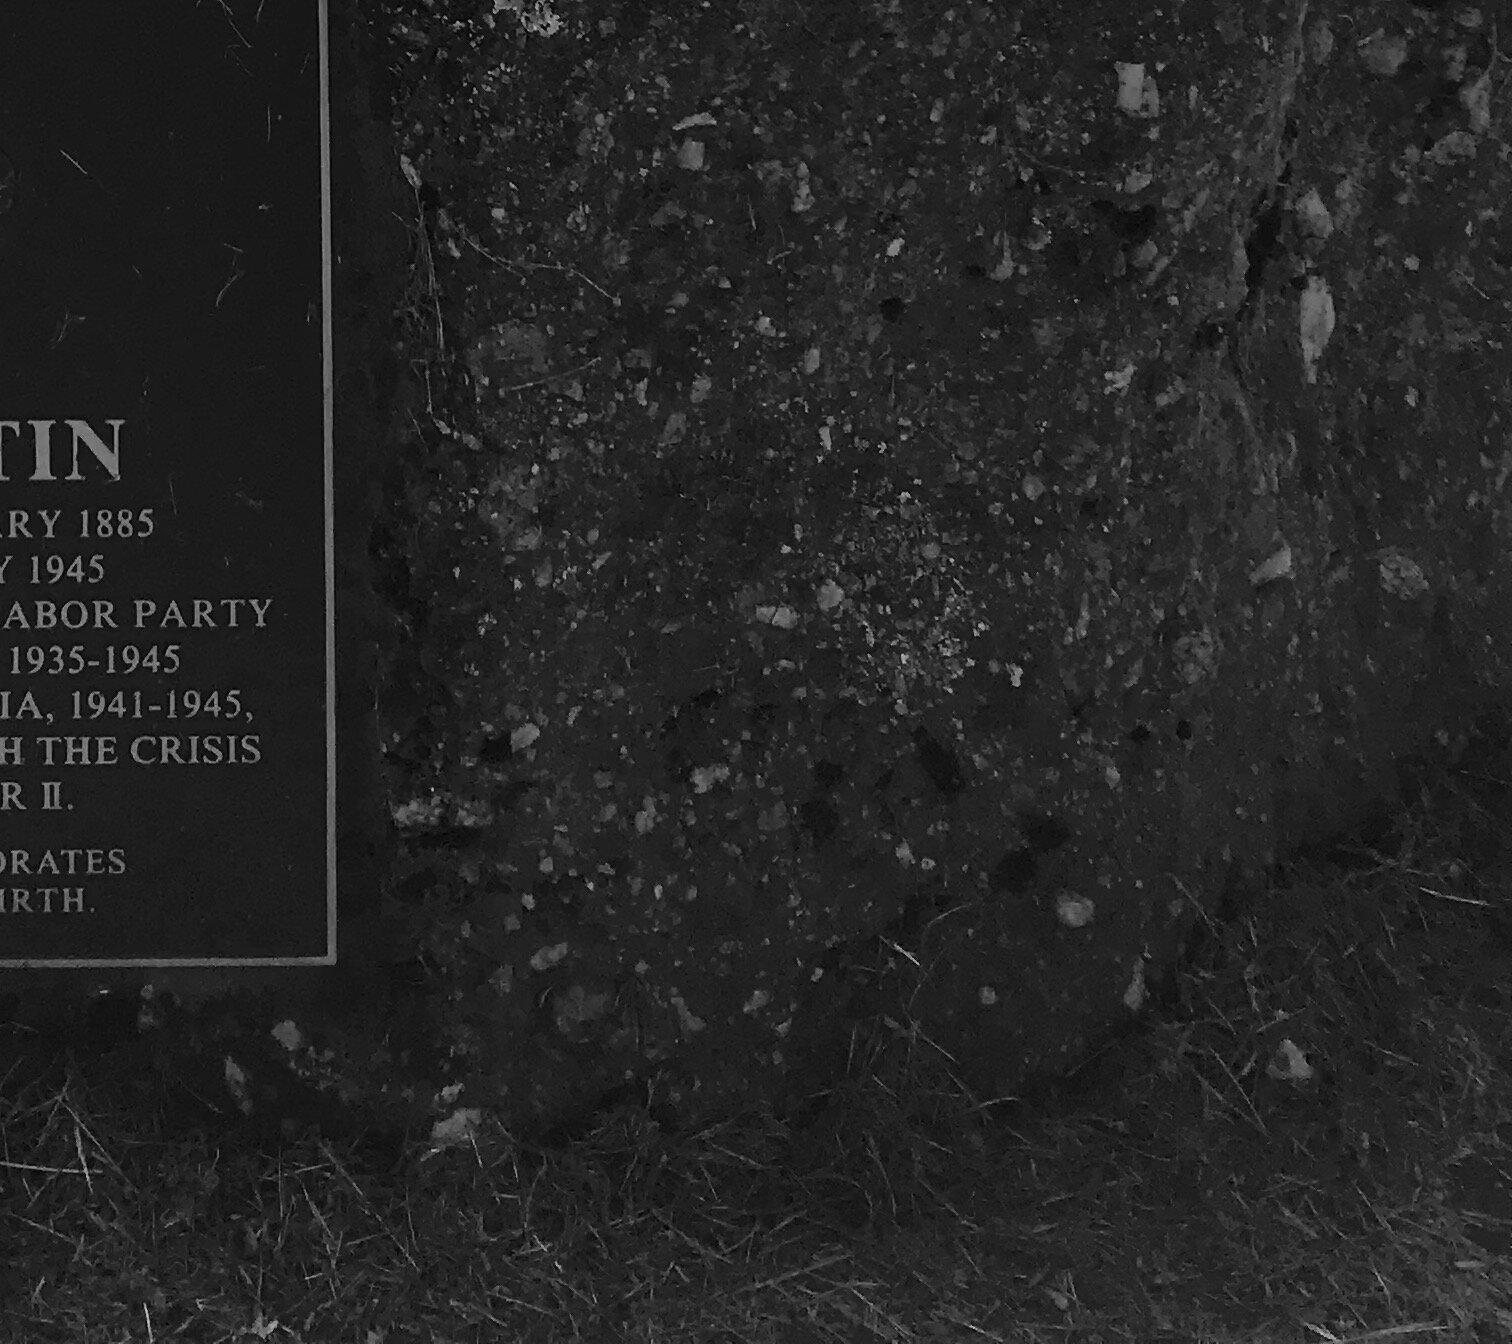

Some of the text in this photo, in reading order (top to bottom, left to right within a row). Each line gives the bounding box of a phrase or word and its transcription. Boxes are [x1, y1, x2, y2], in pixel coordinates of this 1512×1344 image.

[80, 508, 154, 538] 1885
[30, 554, 105, 584] 1945
[133, 598, 273, 628] PARTY
[10, 644, 180, 675] 1935-1945
[71, 689, 253, 723] 1941-1945,
[36, 736, 119, 766] THE
[130, 734, 261, 765] CRISIS
[41, 781, 74, 811] II.
